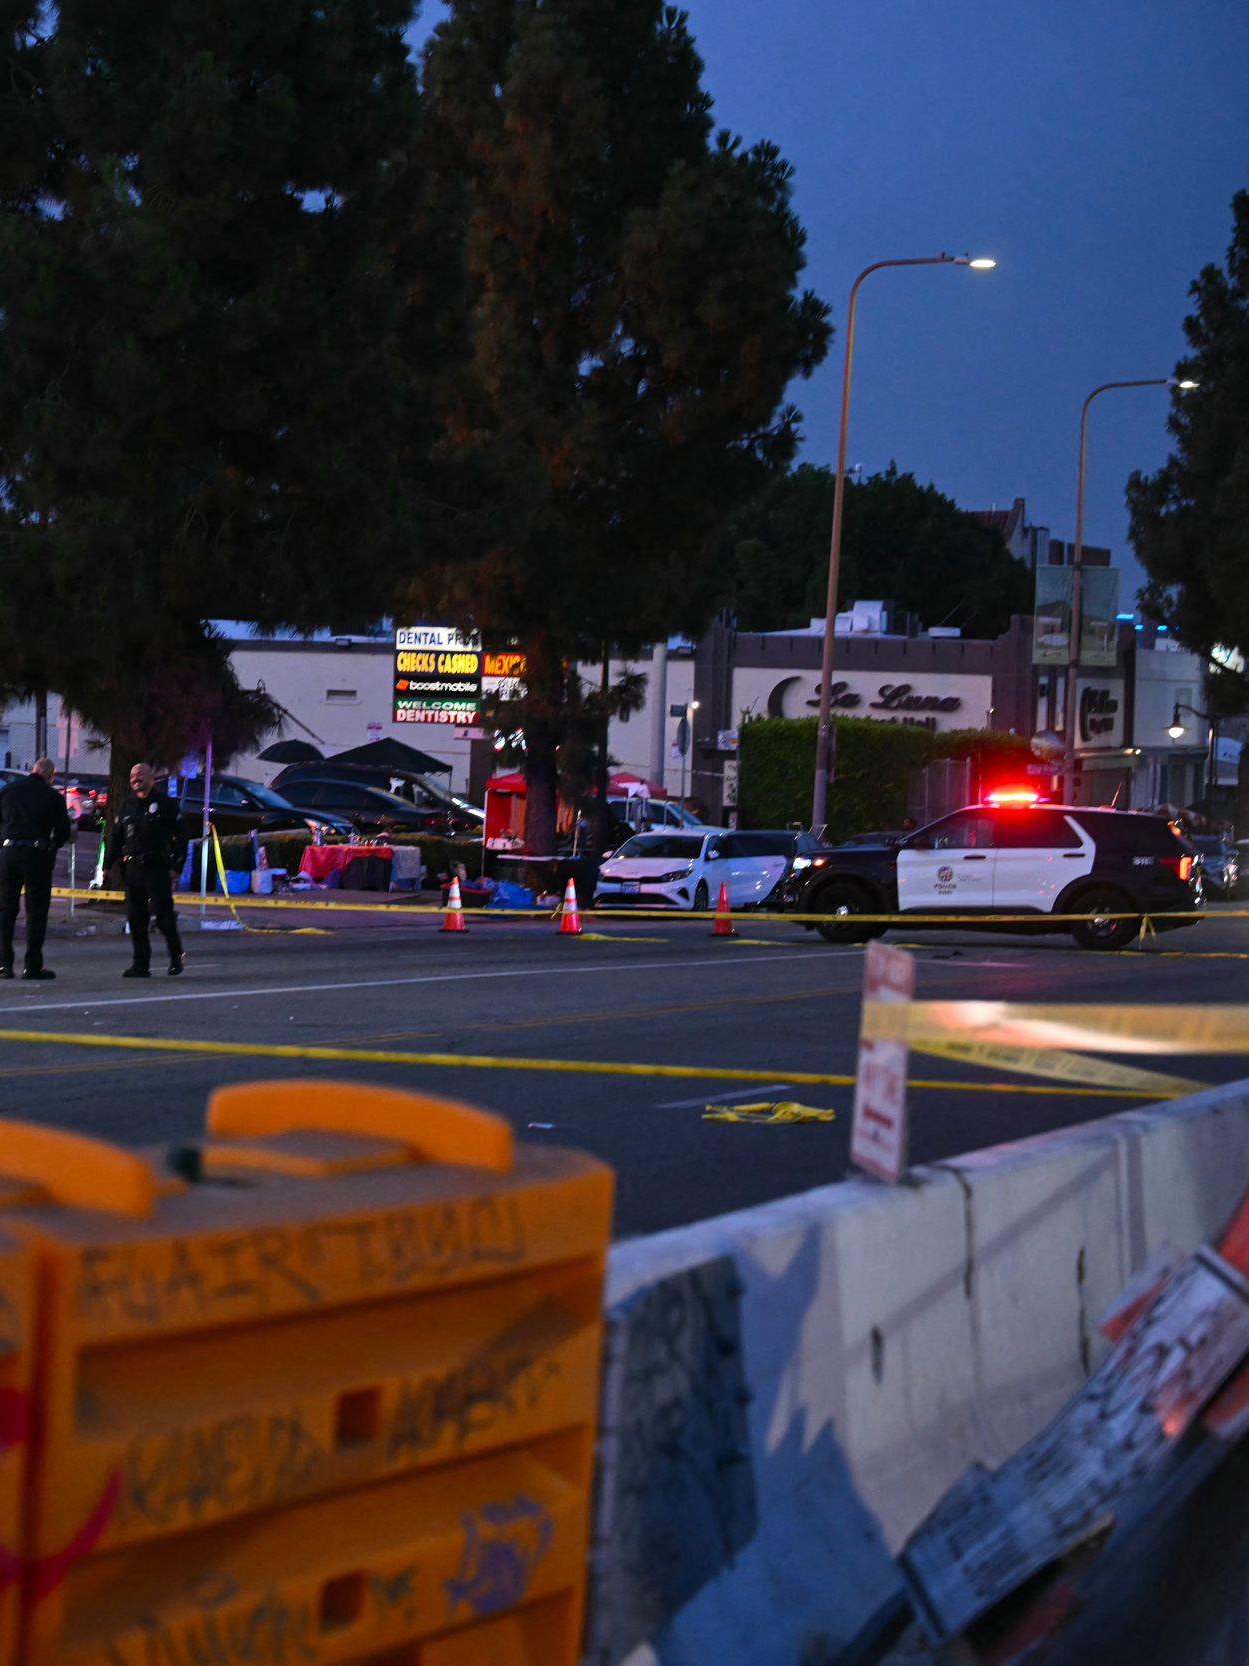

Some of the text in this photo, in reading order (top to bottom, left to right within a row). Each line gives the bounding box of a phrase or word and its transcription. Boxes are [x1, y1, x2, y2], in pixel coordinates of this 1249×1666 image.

[398, 631, 443, 645] DENTAL
[396, 651, 479, 674] CHECKS CASHED
[805, 681, 961, 713] La Luna
[397, 700, 477, 711] WELCOME
[396, 709, 477, 724] DENTISTRY
